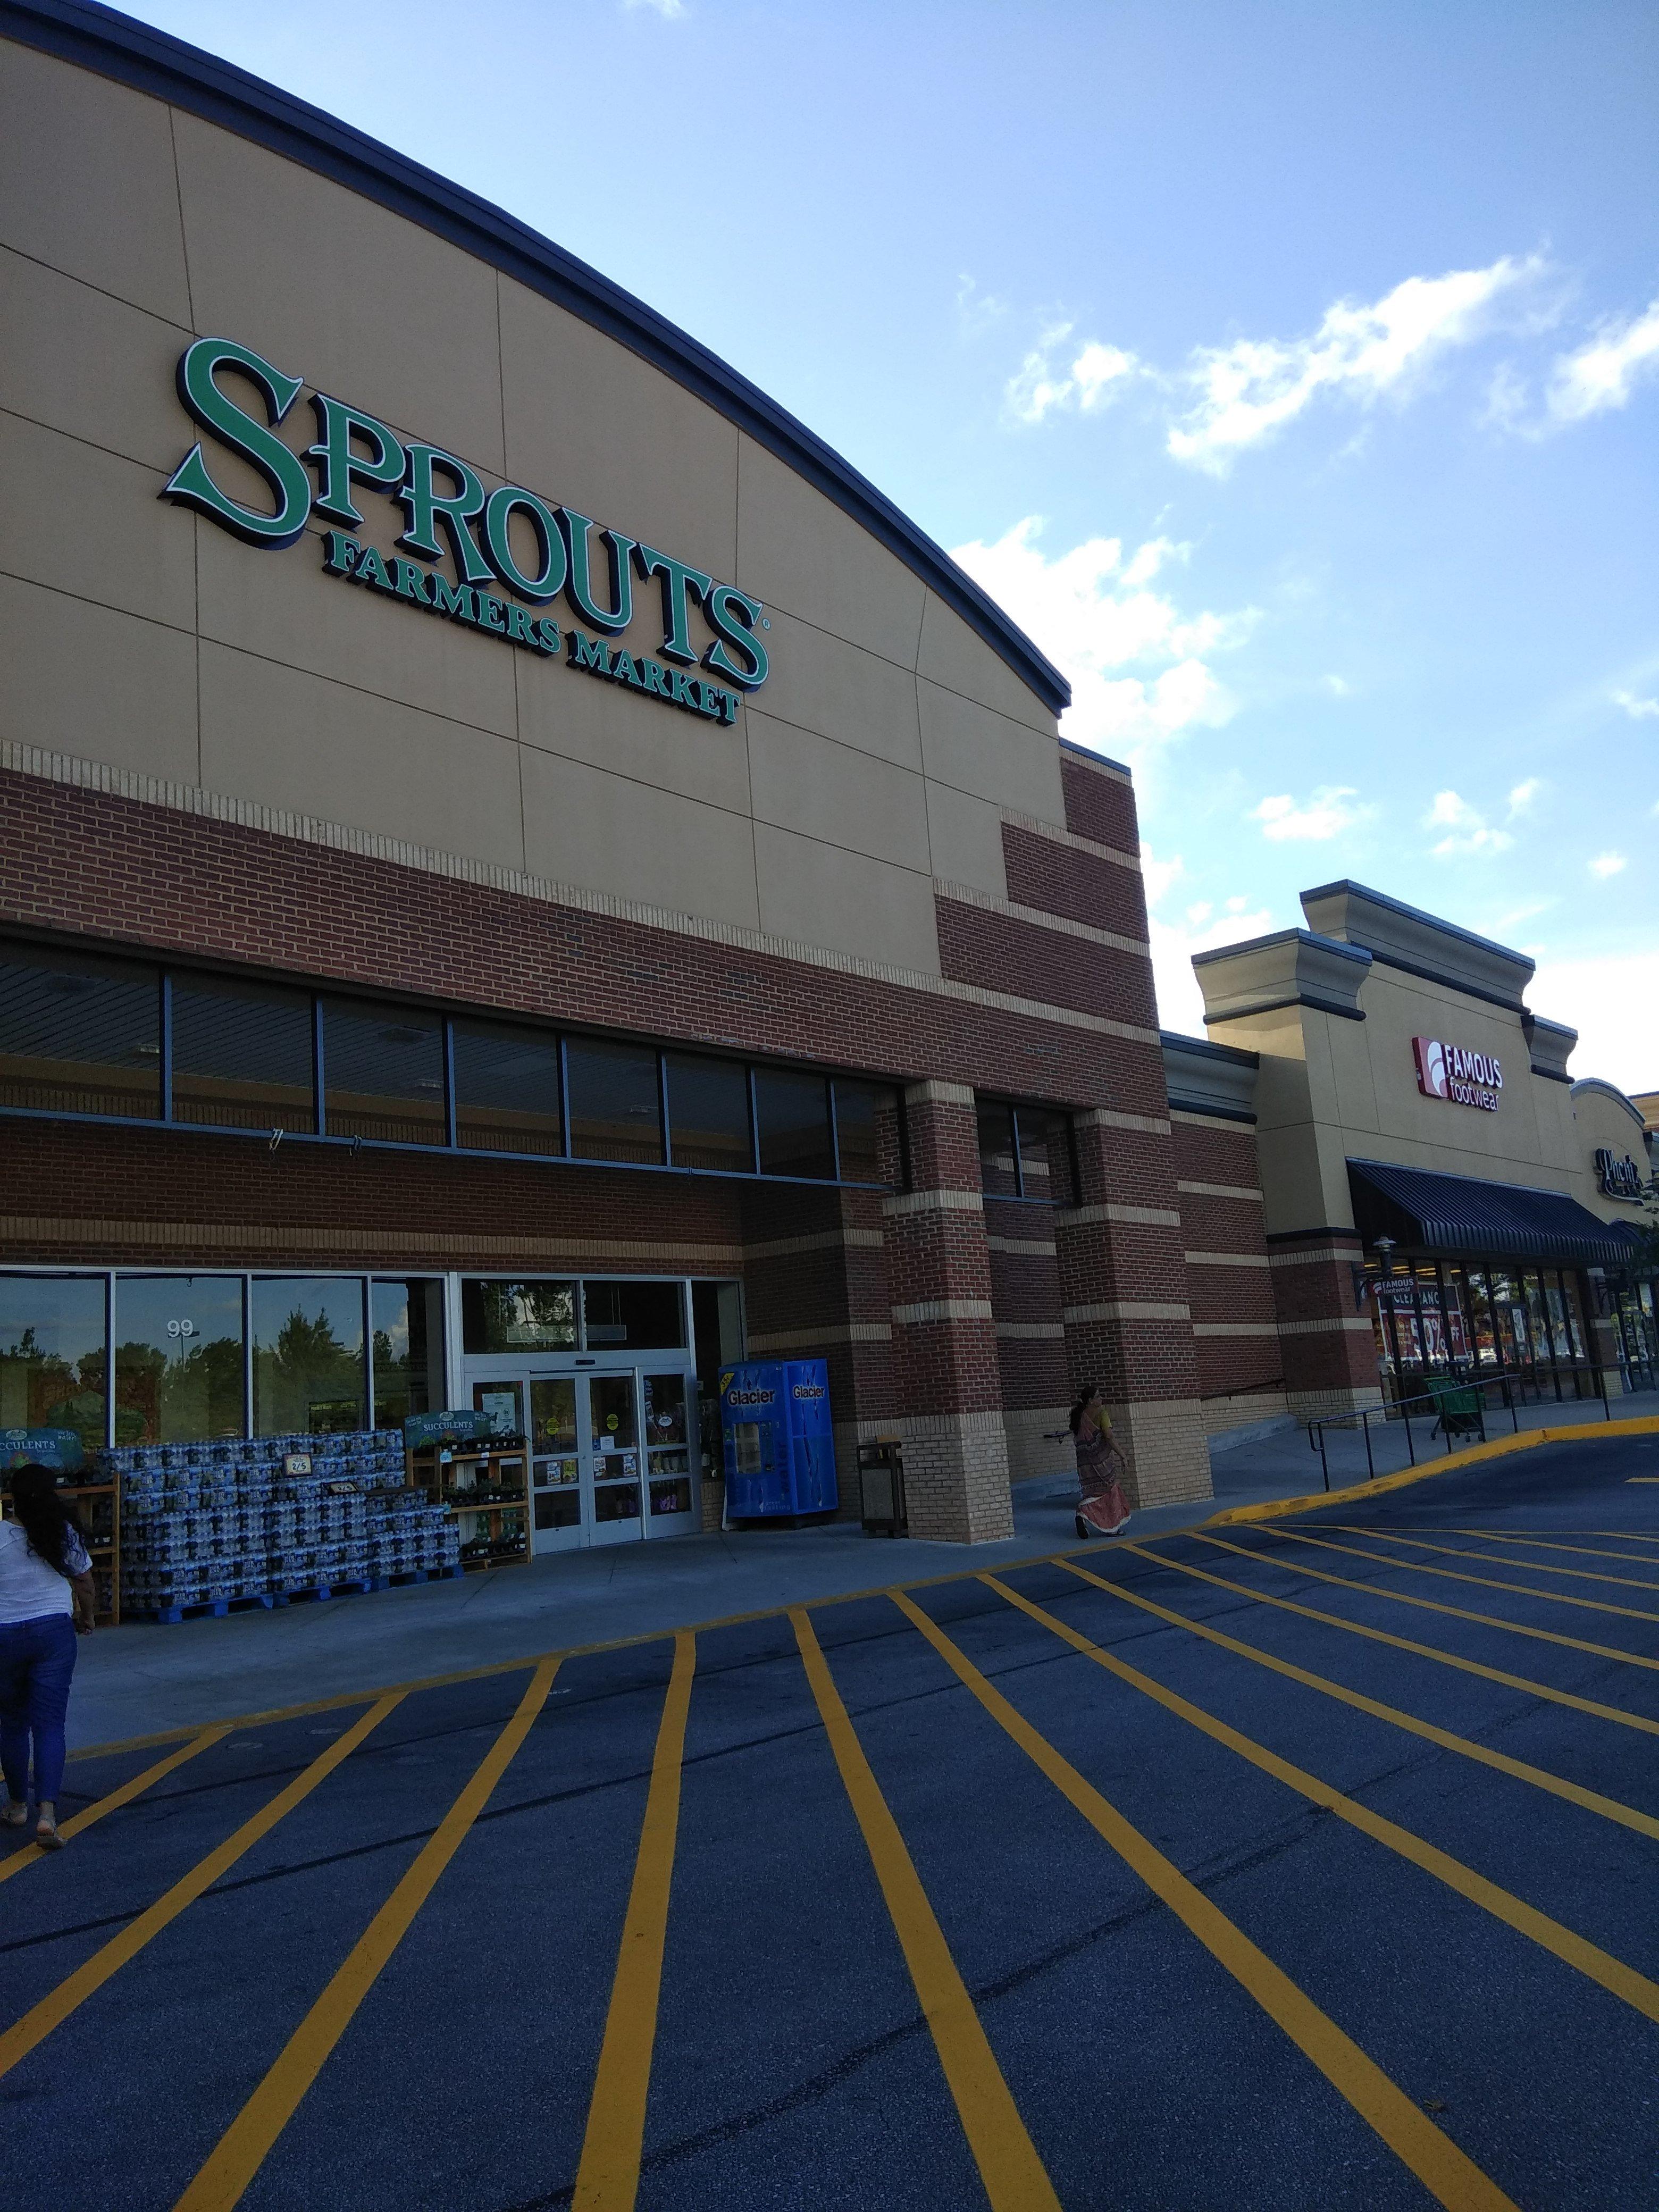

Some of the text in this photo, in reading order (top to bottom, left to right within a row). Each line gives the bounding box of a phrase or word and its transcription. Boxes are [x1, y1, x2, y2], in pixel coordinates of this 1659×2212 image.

[162, 337, 770, 689] SPROUTS
[325, 529, 741, 725] FARMERS MARKET
[1443, 1044, 1503, 1088] FAMOUS
[1449, 1076, 1499, 1111] footwear
[1382, 1278, 1414, 1289] FAMOUS
[167, 1319, 194, 1337] 99
[728, 1389, 775, 1405] Glacier
[793, 1385, 825, 1399] Glacier
[423, 1421, 474, 1432] SUCCULENTS
